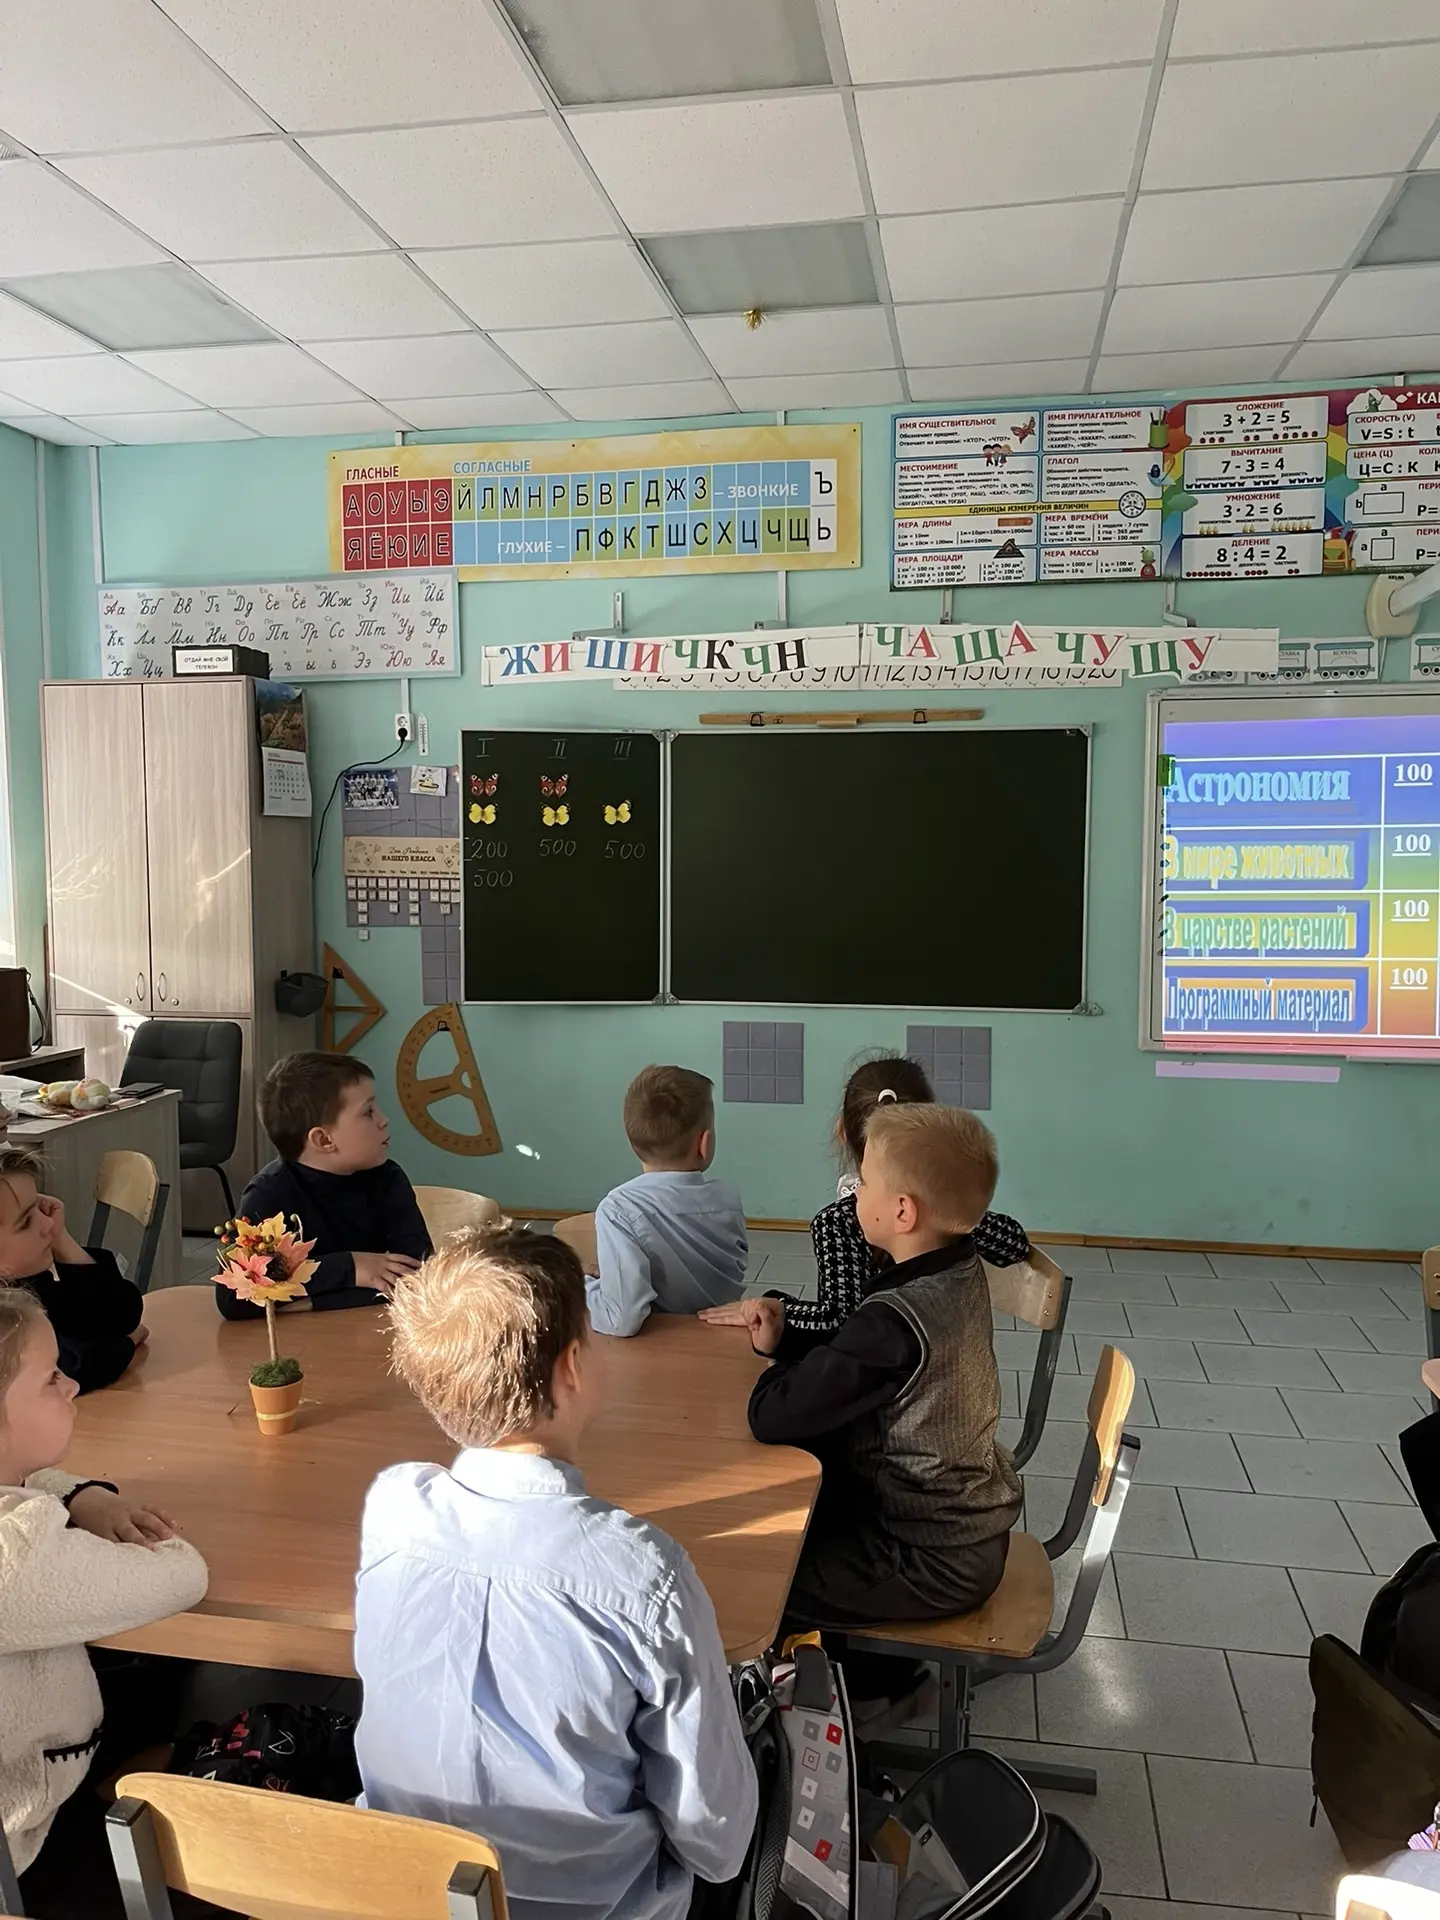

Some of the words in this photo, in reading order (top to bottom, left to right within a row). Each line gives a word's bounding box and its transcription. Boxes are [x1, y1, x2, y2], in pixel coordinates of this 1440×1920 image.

[1417, 392, 1440, 404] КА
[1236, 402, 1284, 411] СЛОЖЕНИЕ
[918, 418, 996, 428] СУЩЕСТВИТЕЛЬНОЕ
[1068, 410, 1142, 420] ПРИЛАГАТЕЛЬНОЕ
[1223, 414, 1232, 427] 3
[1252, 412, 1260, 425] 2
[1280, 410, 1290, 424] 5
[1355, 416, 1400, 424] СКОРОСТЬ
[1402, 414, 1415, 422] (V)
[1230, 447, 1282, 456] ВЫЧИТАНИЕ
[1380, 450, 1393, 458] (Ц)
[346, 466, 399, 480] ГЛАСНЫЕ
[454, 460, 530, 474] СОГЛАСНЫЕ
[900, 463, 958, 472] МЕСТОИМЕНИЕ
[1222, 461, 1230, 474] 7
[1246, 460, 1255, 472] 3
[1275, 458, 1284, 470] 4
[346, 494, 360, 518] А
[366, 492, 384, 516] О
[388, 490, 404, 515] У
[410, 490, 428, 514] Ы
[434, 488, 450, 512] Э
[458, 484, 471, 510] Й
[480, 488, 494, 510] Л
[504, 487, 519, 508] М
[528, 486, 542, 508] Н
[553, 485, 566, 507] Р
[576, 484, 588, 506] Б
[600, 483, 612, 504] В
[624, 482, 634, 503] Г
[645, 480, 660, 508] Д
[666, 479, 686, 500] Ж
[694, 477, 706, 500] З
[728, 484, 798, 498] ЗВОНКИЕ
[815, 472, 832, 494] Ъ
[1226, 493, 1280, 502] УМНОЖЕНИЕ
[969, 506, 1006, 514] ЕДИНИЦЫ
[1008, 504, 1052, 512] ИЗМЕРЕНИЯ
[1223, 505, 1232, 518] 3
[1245, 504, 1254, 516] 2
[1274, 502, 1282, 515] 6
[922, 520, 952, 528] ДЛИНЫ
[348, 537, 362, 560] Я
[370, 532, 382, 559] Ё
[388, 534, 407, 558] Ю
[413, 534, 426, 558] И
[437, 533, 450, 556] Е
[498, 541, 552, 554] ГЛУХИЕ
[1232, 538, 1271, 548] ДЕЛЕНИЕ
[898, 556, 918, 564] МЕРА
[922, 554, 963, 562] ПЛОЩАДИ
[1217, 548, 1227, 562] 8
[1244, 548, 1254, 561] 4
[1276, 546, 1286, 560] 2
[104, 600, 125, 616] Аа
[140, 598, 164, 615] Бб
[173, 598, 192, 614] Вв
[205, 596, 220, 613] Гг
[234, 595, 253, 618] Дд
[265, 594, 280, 610] Ее
[292, 590, 306, 609] Ёё
[318, 591, 352, 608] Жж
[362, 588, 378, 612] Зз
[392, 588, 410, 604] Ии
[424, 583, 444, 602] Йй
[107, 630, 124, 646] Кк
[134, 630, 155, 644] Лл
[165, 629, 194, 644] Мм
[206, 626, 228, 644] Нн
[238, 626, 255, 642] Оо
[266, 624, 289, 640] Пп
[301, 623, 318, 645] Рр
[330, 622, 344, 638] Сс
[355, 620, 386, 636] Тт
[398, 617, 414, 642] Уу
[426, 617, 448, 639] Фф
[500, 642, 572, 677] ЖИ
[584, 639, 666, 672] ШИ
[672, 639, 736, 670] ЧК
[742, 638, 810, 675] ЧН
[875, 626, 938, 658] ЧА
[952, 624, 1038, 666] ЩА
[1056, 632, 1123, 666] ЧУ
[1128, 635, 1216, 680] ЩУ
[108, 661, 132, 676] Хх
[142, 660, 164, 678] Цц
[354, 652, 372, 669] Ээ
[386, 650, 412, 667] Юю
[425, 650, 445, 666] Яя
[548, 738, 567, 758] II
[1166, 768, 1351, 806] Астрономия
[1395, 763, 1432, 782] 100
[472, 840, 507, 858] 200
[540, 838, 576, 856] 500
[605, 840, 645, 859] 500
[1184, 846, 1237, 889] мире
[1241, 845, 1348, 878] животных
[1394, 834, 1431, 852] 100
[1181, 918, 1253, 956] царстве
[1259, 905, 1348, 956] растений
[1392, 900, 1430, 918] 100
[1168, 977, 1274, 1030] Программный
[1277, 989, 1352, 1032] материал
[1391, 968, 1428, 986] 100
